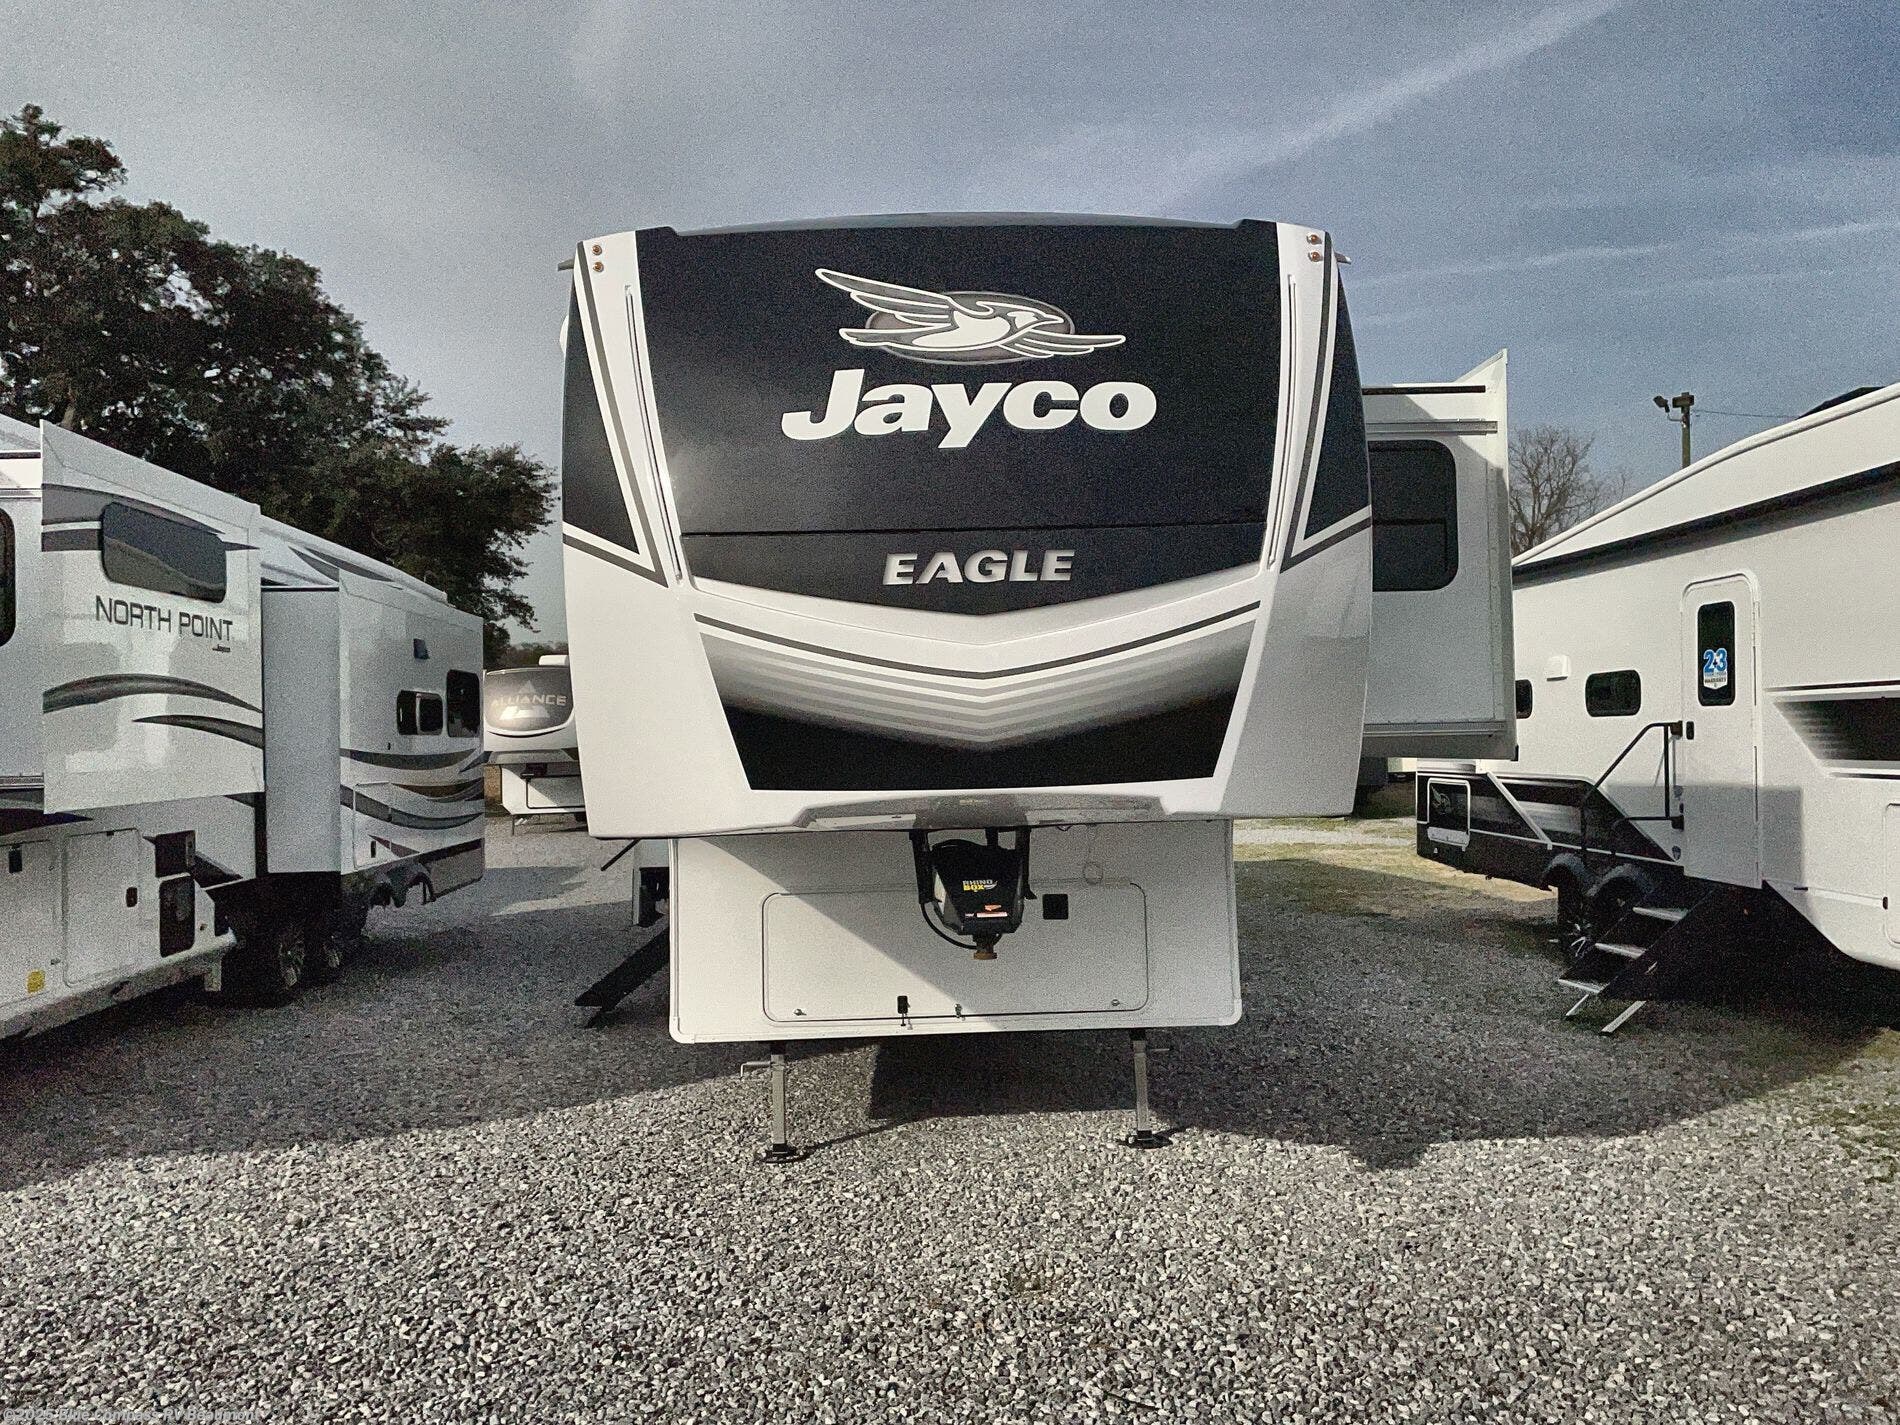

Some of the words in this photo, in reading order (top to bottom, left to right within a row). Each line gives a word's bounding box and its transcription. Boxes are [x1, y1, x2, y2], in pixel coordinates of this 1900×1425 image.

[781, 368, 1157, 448] Jayco
[882, 549, 1076, 586] EAGLE
[95, 595, 172, 633] NORTH
[179, 611, 234, 642] POINT
[490, 694, 568, 707] ALLIANCE
